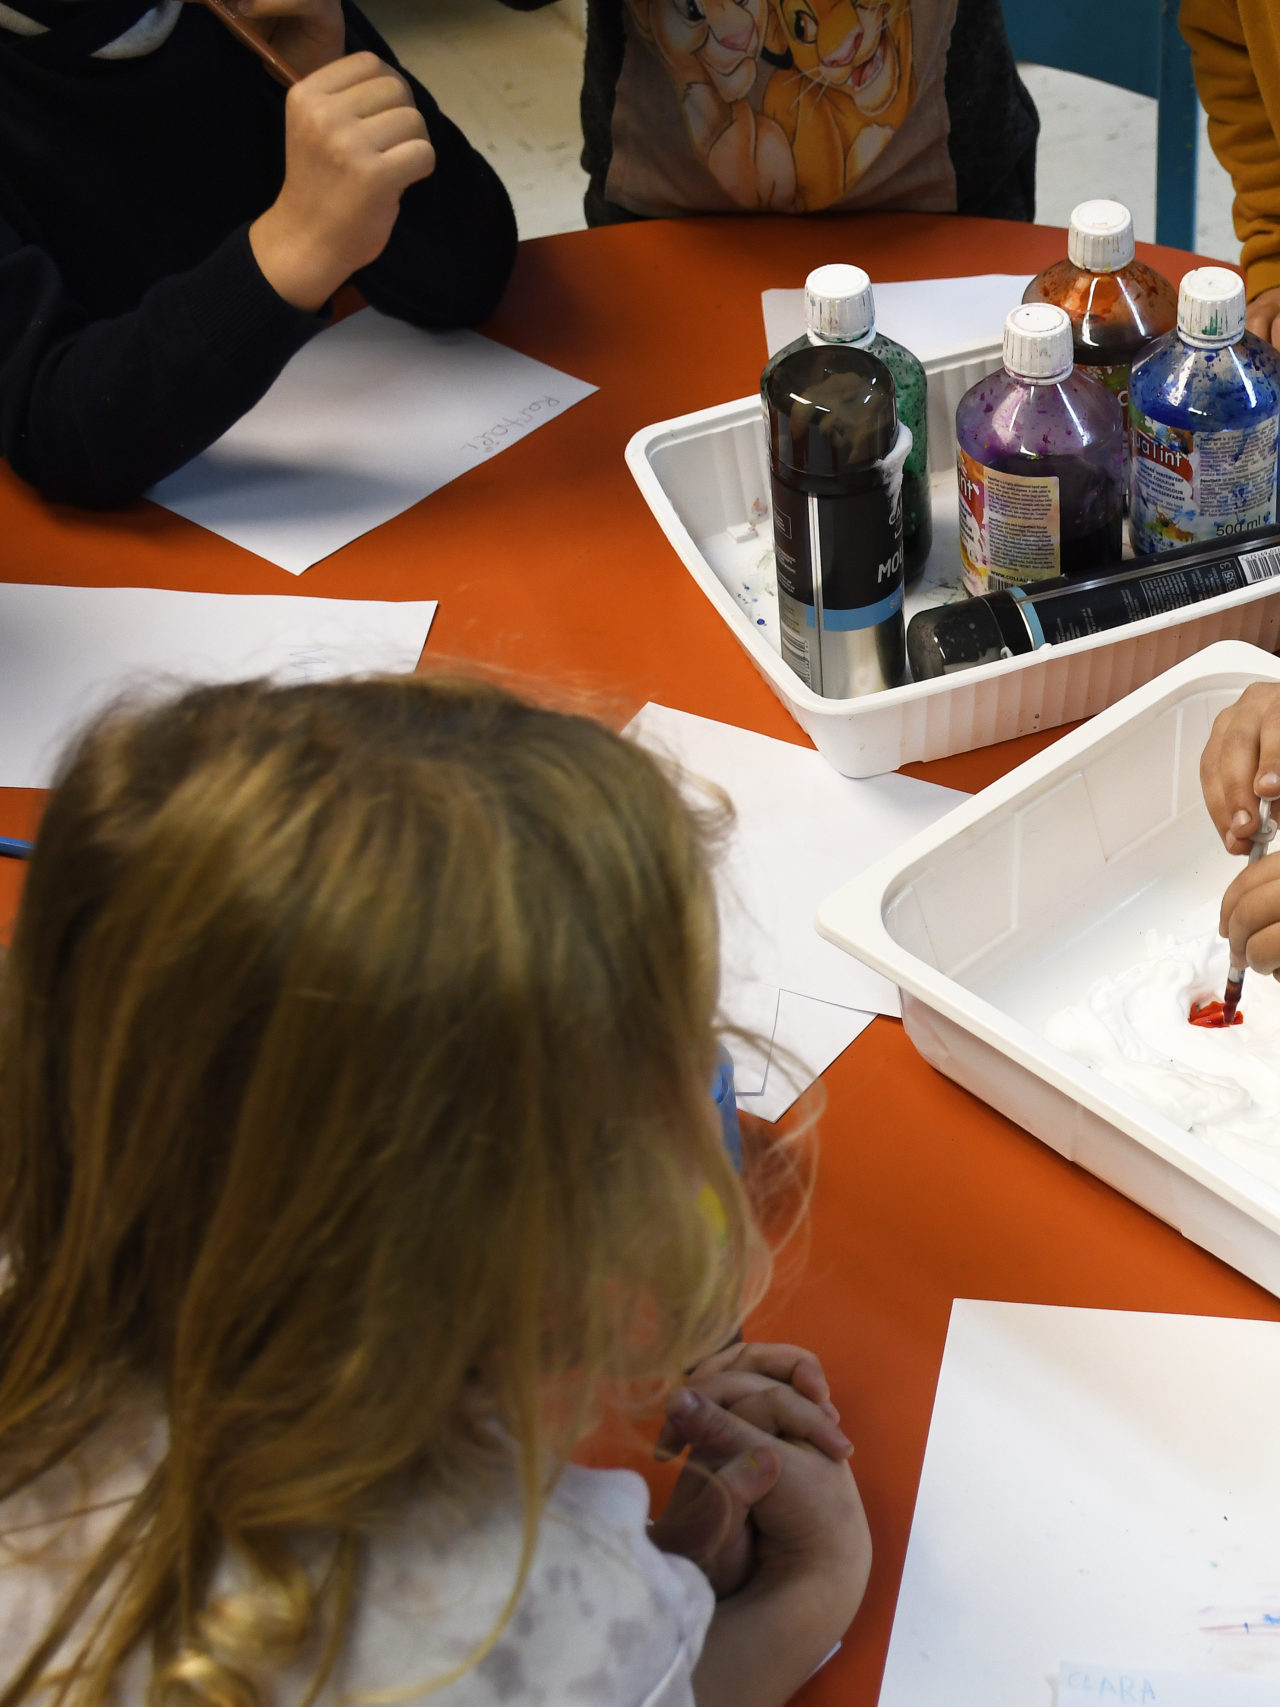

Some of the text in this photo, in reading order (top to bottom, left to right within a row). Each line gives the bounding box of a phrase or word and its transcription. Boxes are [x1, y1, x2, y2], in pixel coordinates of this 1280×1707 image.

[1134, 434, 1182, 467] uaTint
[1216, 515, 1261, 537] 500 ml
[1067, 1671, 1157, 1704] CLARA
